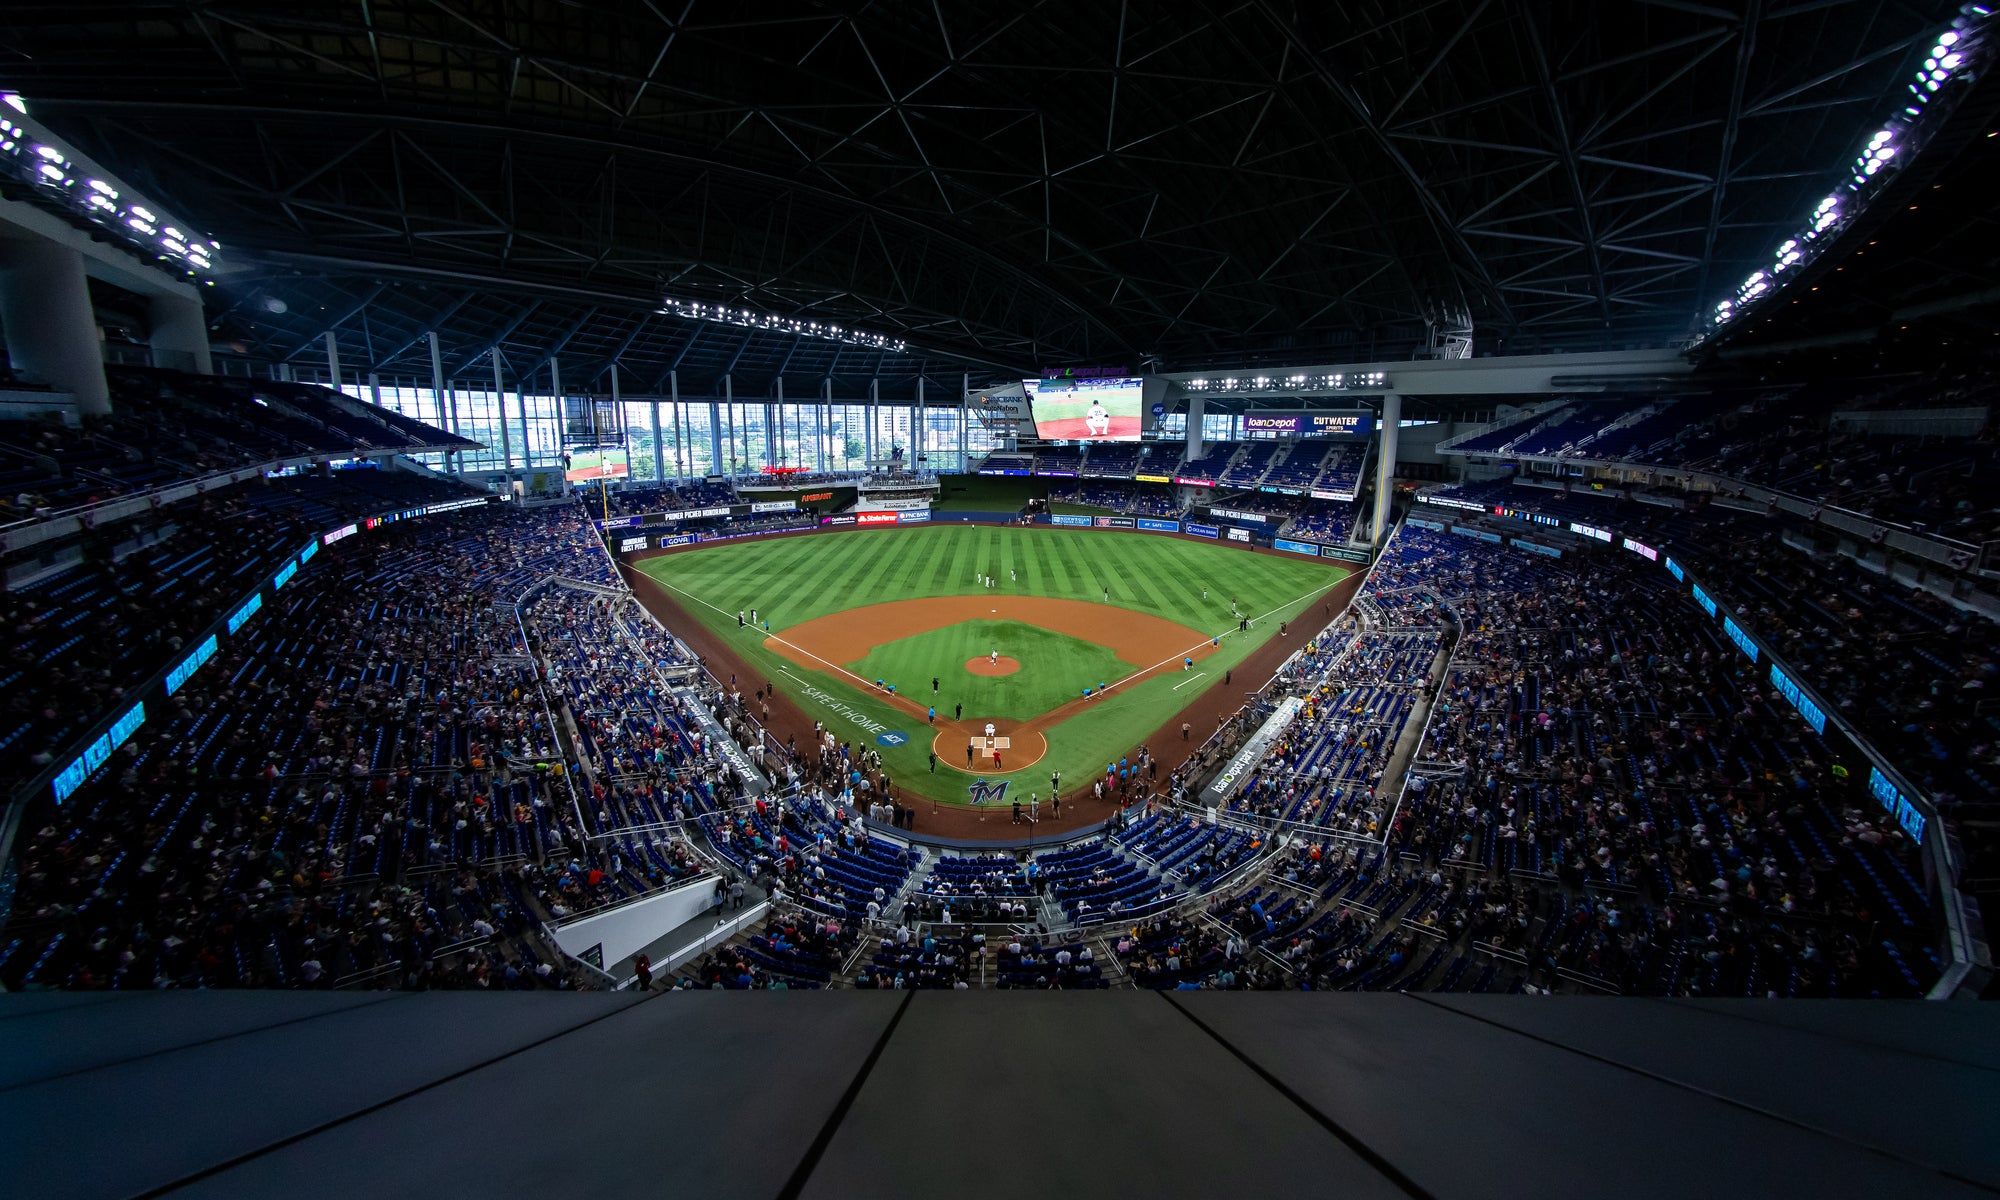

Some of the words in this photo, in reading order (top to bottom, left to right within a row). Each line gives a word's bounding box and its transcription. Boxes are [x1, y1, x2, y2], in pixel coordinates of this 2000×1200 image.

[1248, 418, 1297, 428] loanDepot
[1313, 416, 1358, 426] CUTWATER
[801, 686, 835, 705] SAFE
[827, 702, 851, 712] AT
[841, 709, 887, 734] HOME
[882, 734, 904, 744] ADT
[1211, 761, 1245, 794] loanDepot
[1239, 750, 1256, 765] park
